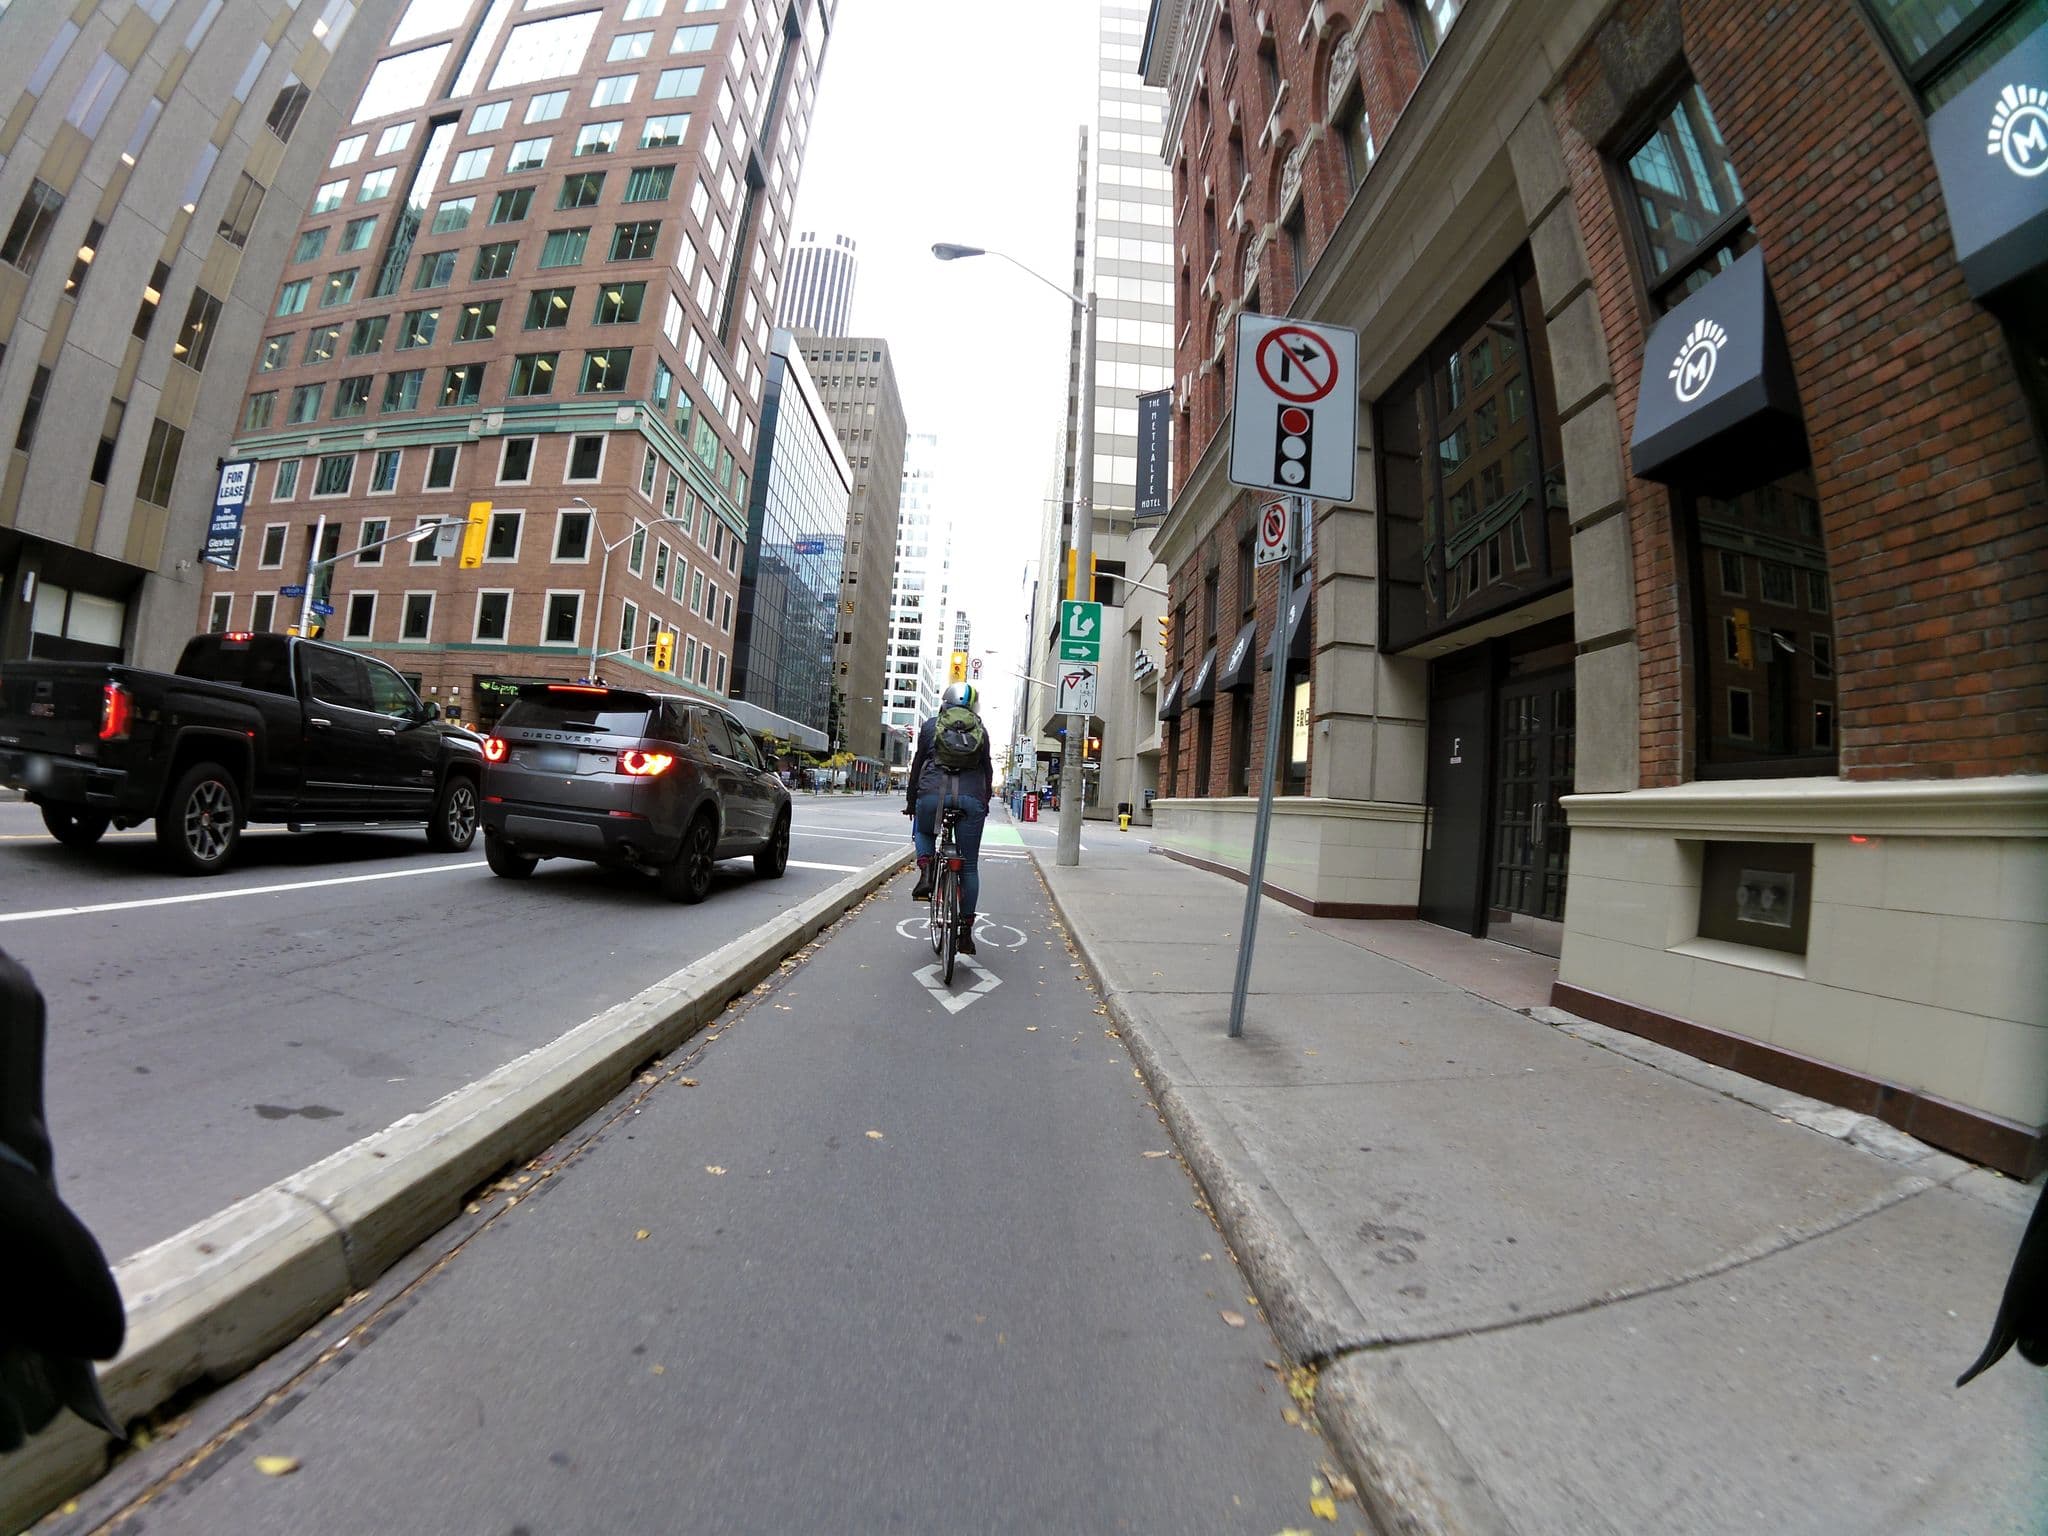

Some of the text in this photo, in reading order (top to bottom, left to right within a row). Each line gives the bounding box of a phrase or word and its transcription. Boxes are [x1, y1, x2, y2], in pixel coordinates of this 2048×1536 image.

[1684, 351, 1708, 391] M
[1149, 398, 1160, 408] THE
[1149, 411, 1158, 495] METCALFE
[226, 470, 244, 484] FOR
[220, 485, 245, 498] LEASE
[1141, 498, 1161, 509] HOTEL
[522, 731, 603, 744] DISCOVERY
